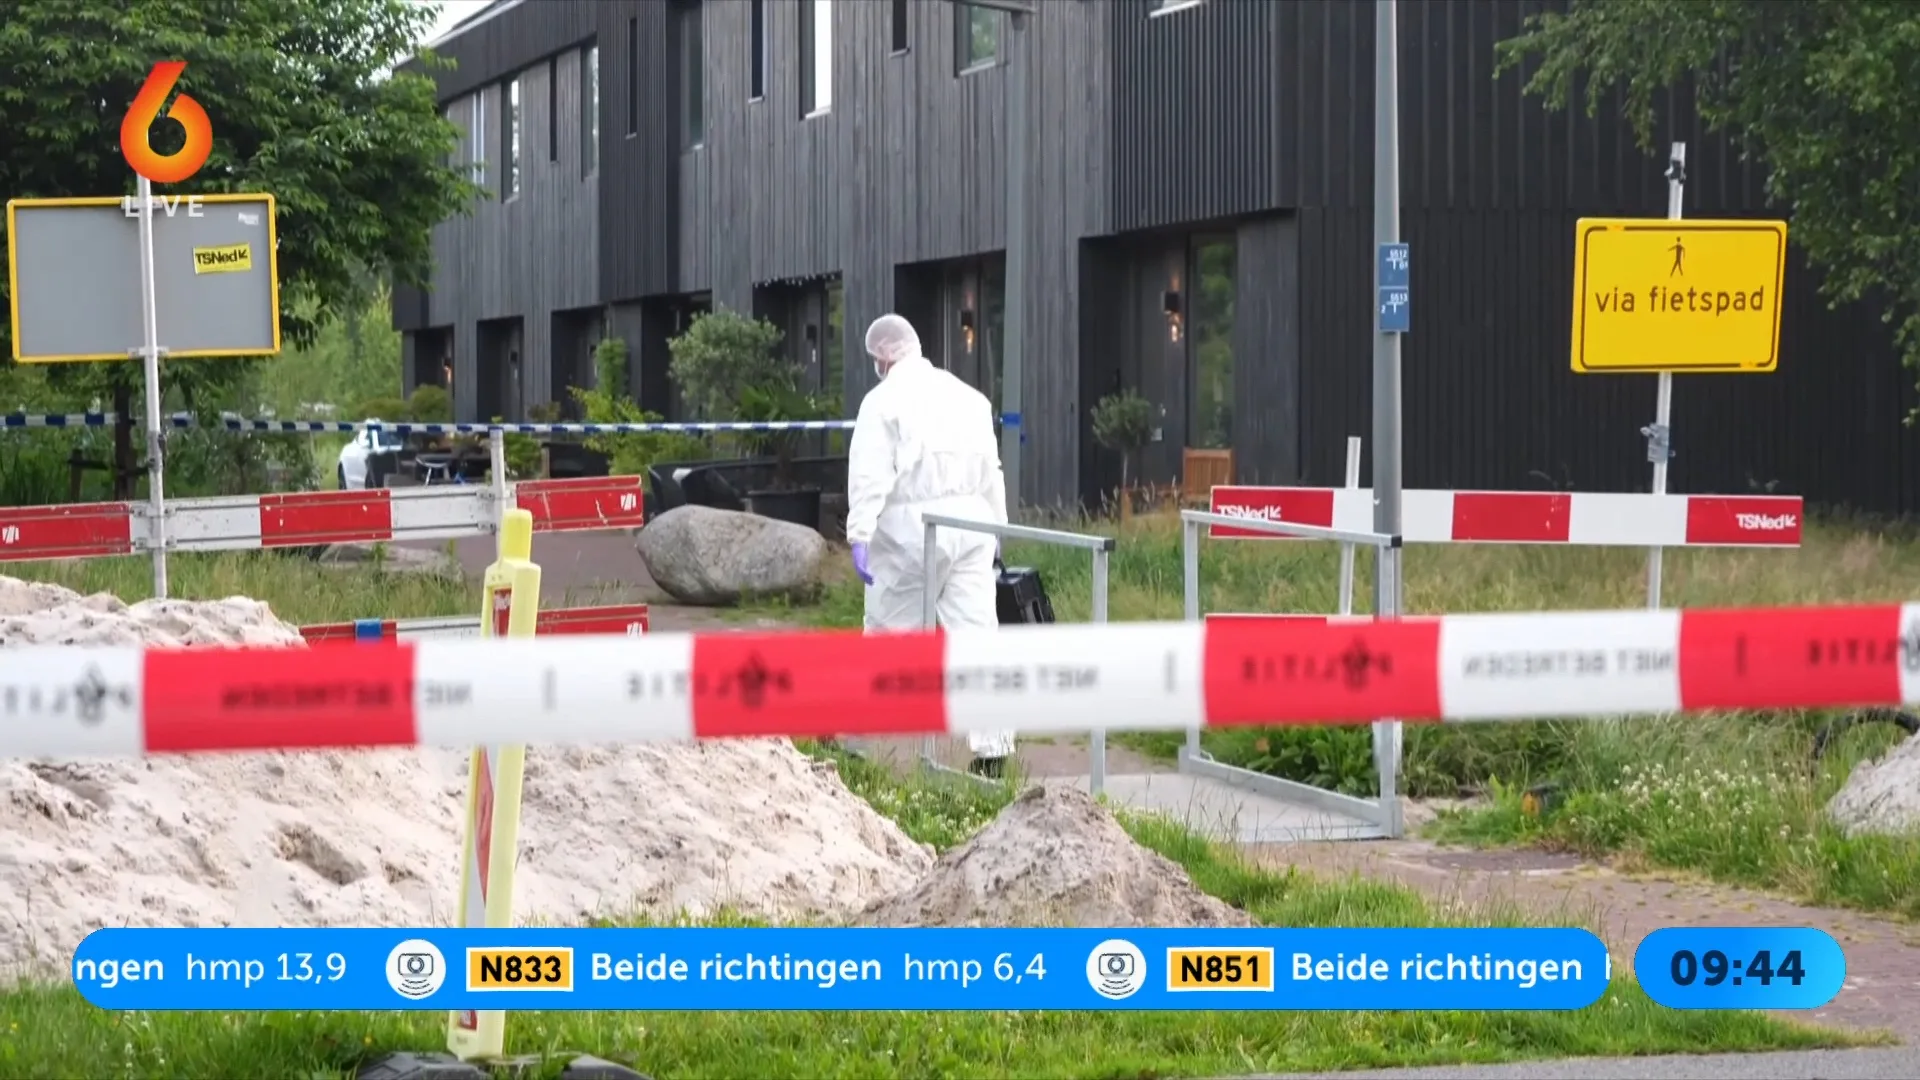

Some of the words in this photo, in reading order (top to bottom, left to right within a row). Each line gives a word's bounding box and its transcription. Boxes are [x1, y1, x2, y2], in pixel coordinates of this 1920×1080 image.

[195, 249, 238, 266] TSNed
[1595, 287, 1636, 313] via
[1649, 285, 1765, 317] fietspad
[1736, 513, 1785, 530] TSNed
